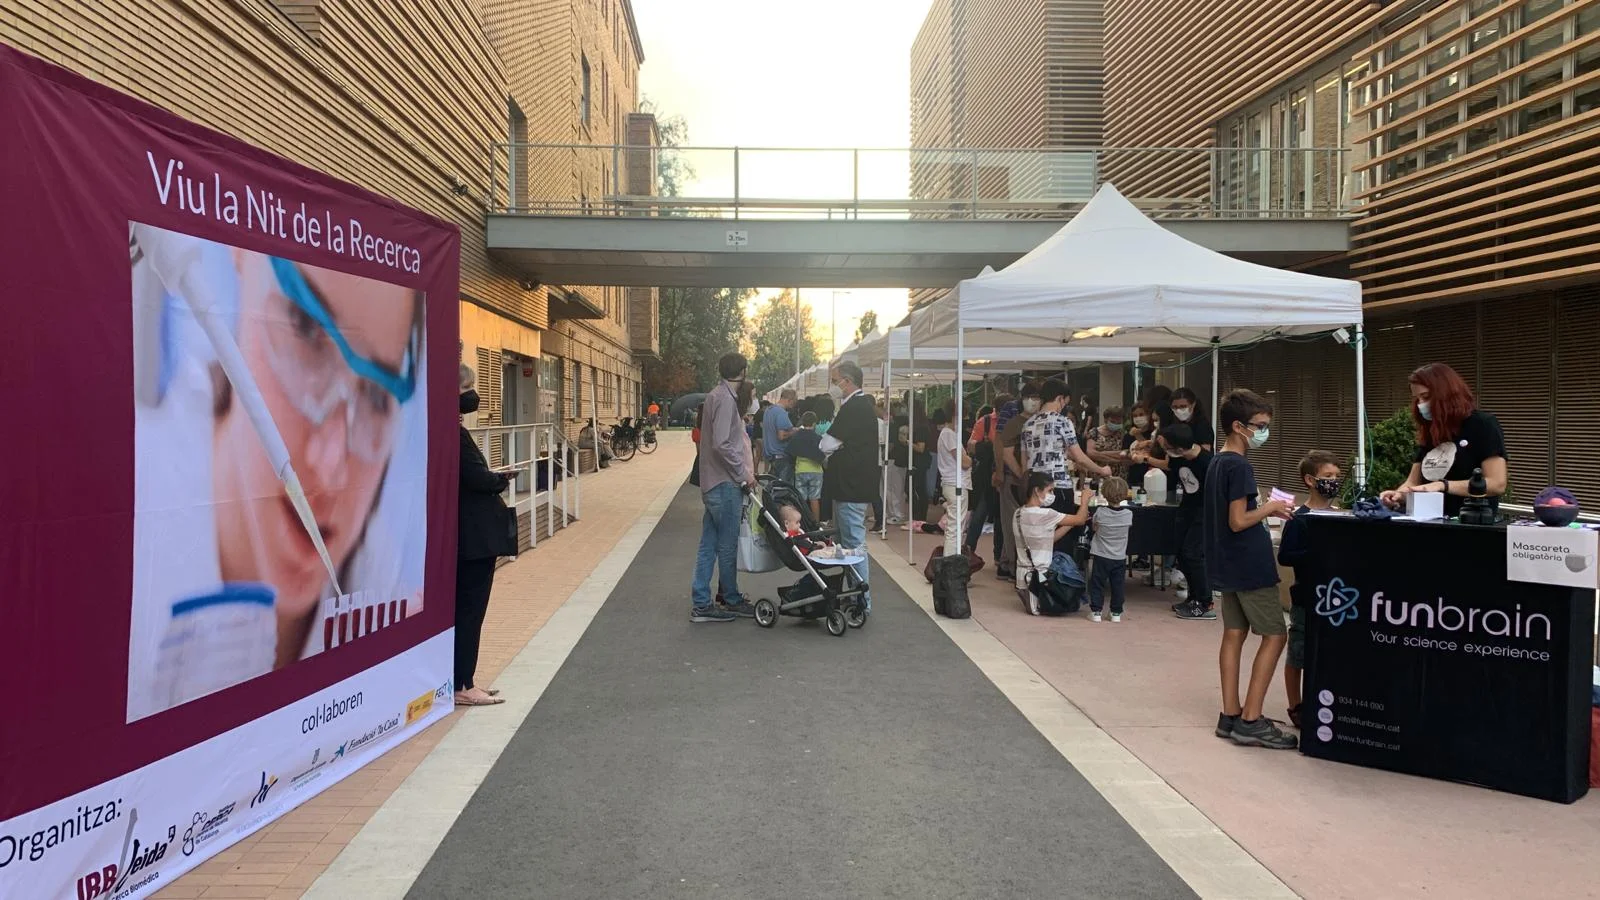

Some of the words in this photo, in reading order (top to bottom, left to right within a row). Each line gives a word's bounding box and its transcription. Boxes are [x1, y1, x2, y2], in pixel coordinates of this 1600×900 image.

[146, 151, 206, 216] Viu
[214, 173, 238, 225] la
[246, 184, 287, 239] Nit
[293, 202, 321, 248] de
[327, 210, 344, 254] la
[350, 218, 421, 274] Recerca
[1512, 542, 1570, 553] Mascareta
[1512, 551, 1563, 562] obligatòria
[1371, 591, 1551, 641] funbrain
[1370, 630, 1397, 644] Your
[1403, 636, 1457, 651] science
[1464, 643, 1550, 662] experience
[1336, 732, 1401, 750] www.funbrain.cat
